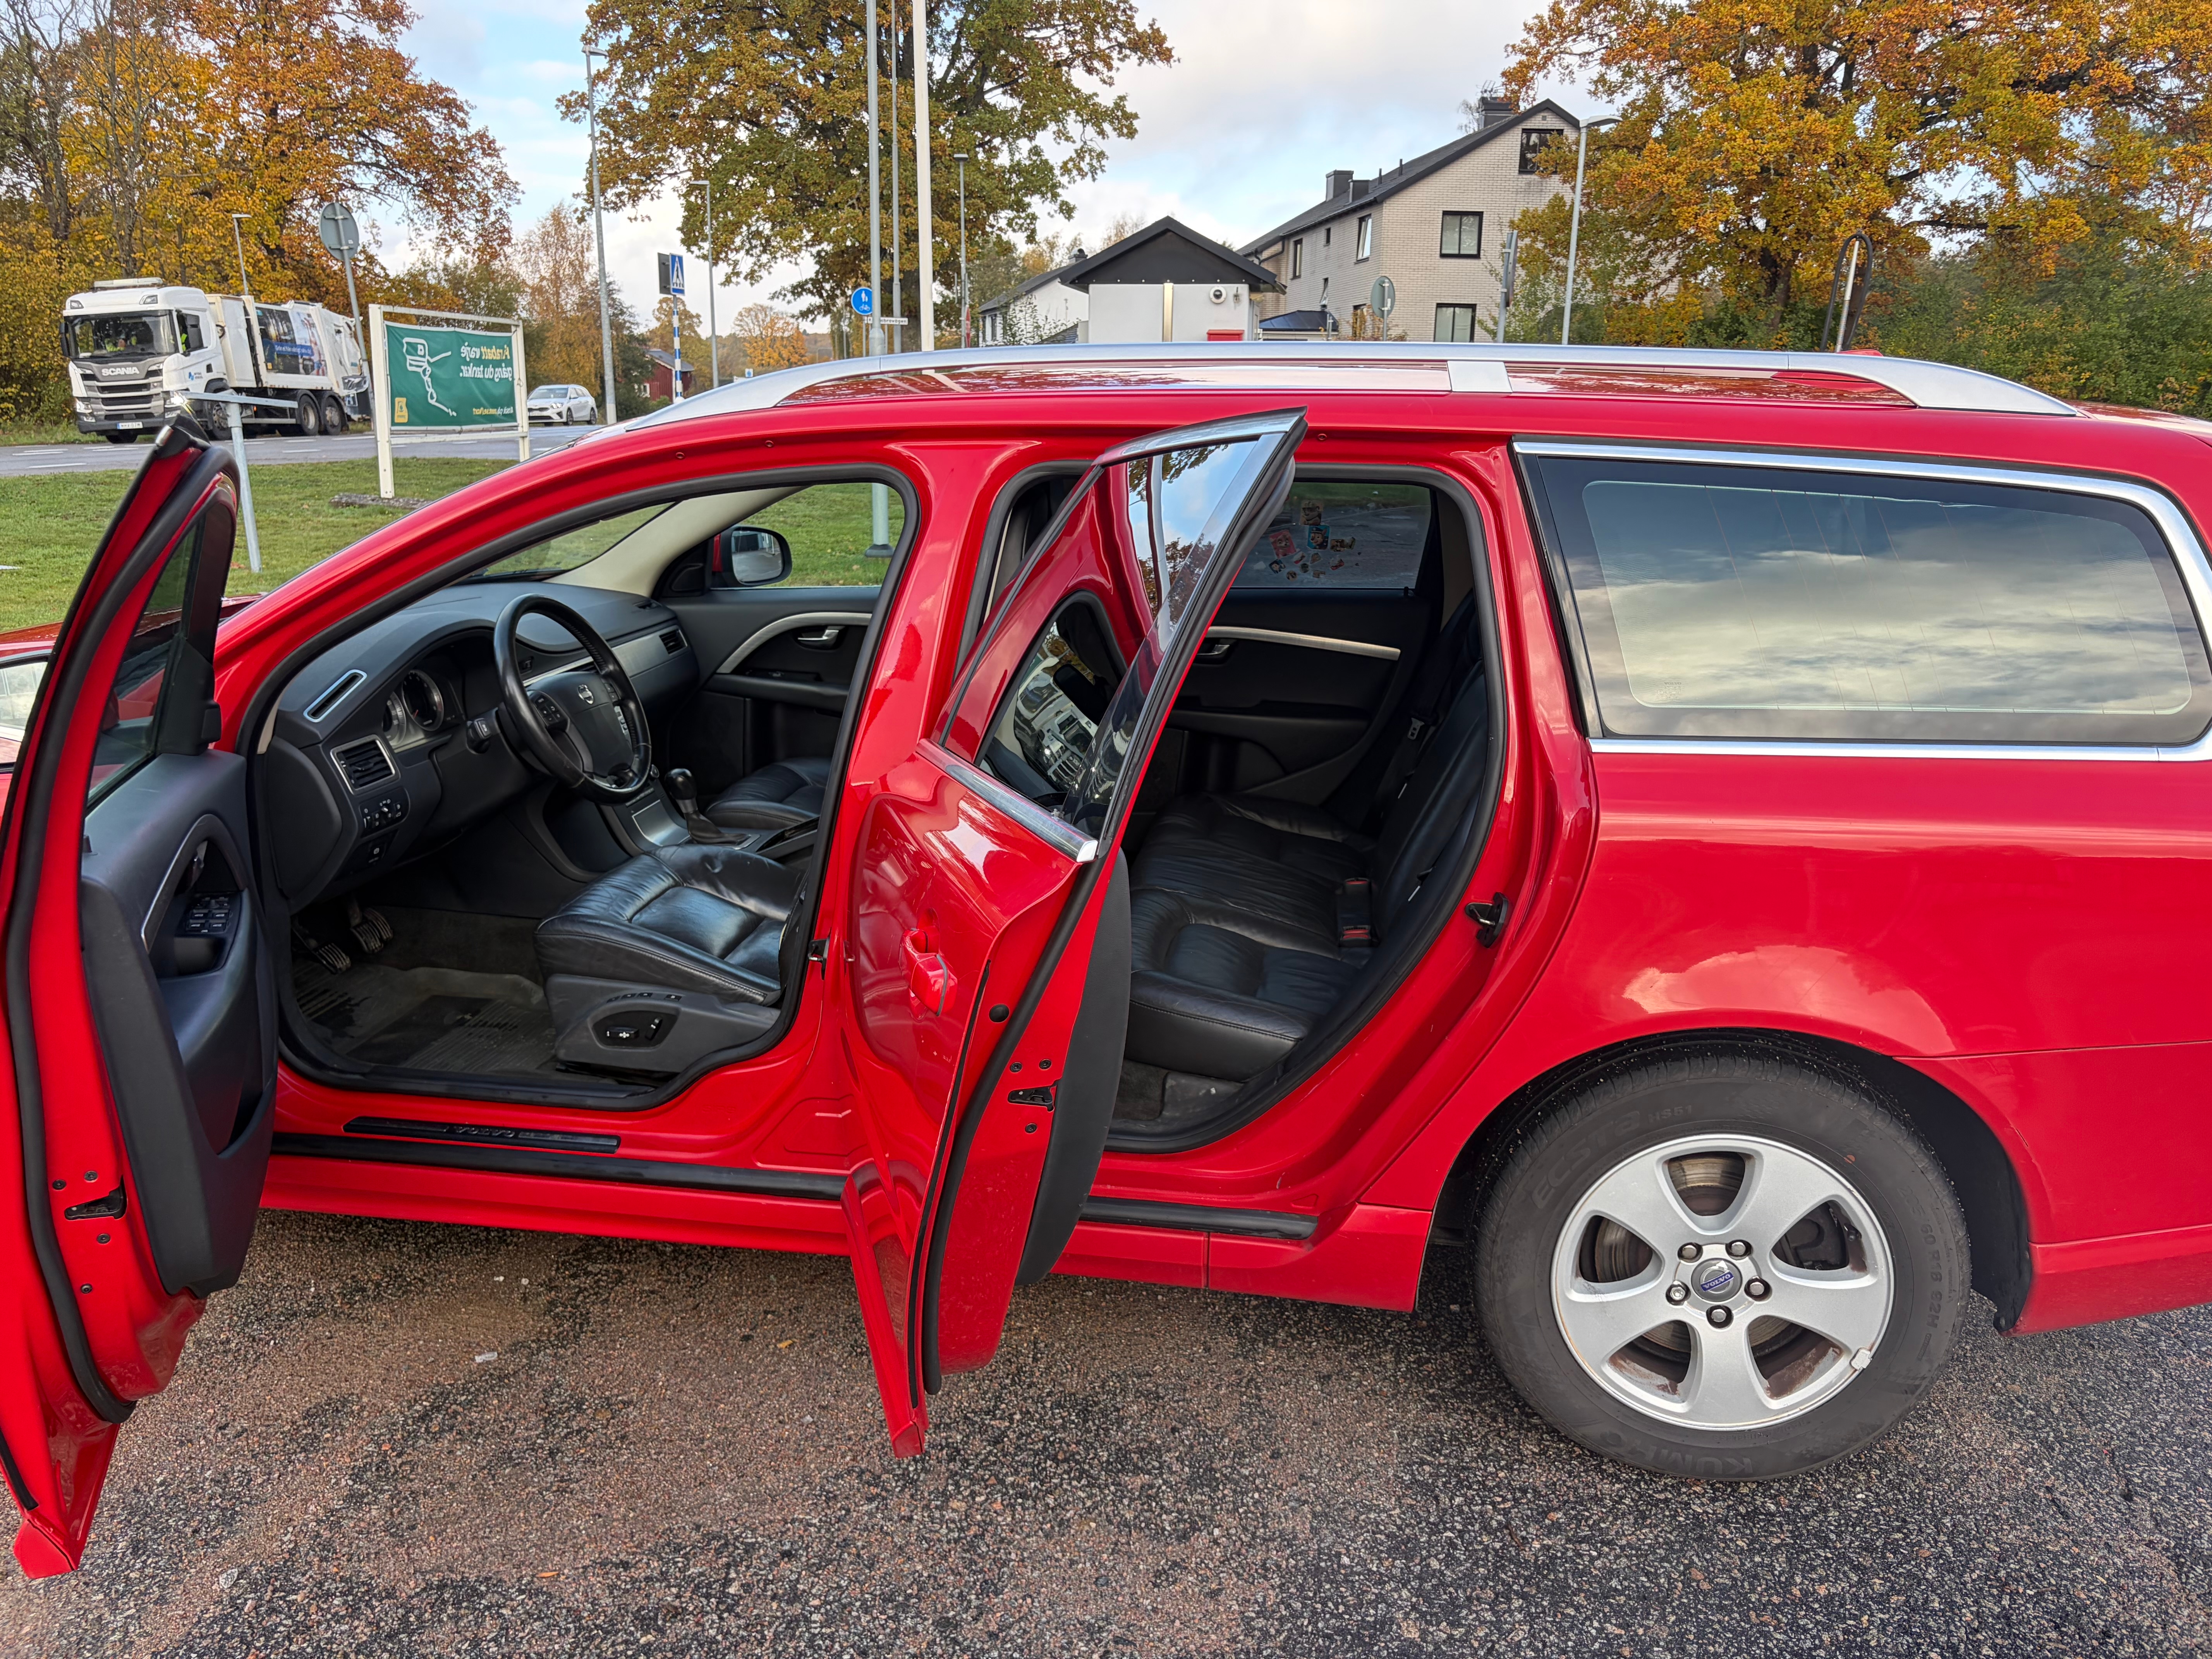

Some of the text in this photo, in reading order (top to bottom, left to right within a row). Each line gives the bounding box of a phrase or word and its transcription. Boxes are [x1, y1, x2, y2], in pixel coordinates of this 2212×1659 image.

[102, 367, 139, 376] SCANIA
[1647, 1104, 1692, 1123] HS51
[1703, 1274, 1730, 1288] VOLVO
[1926, 1291, 1942, 1328] 92H
